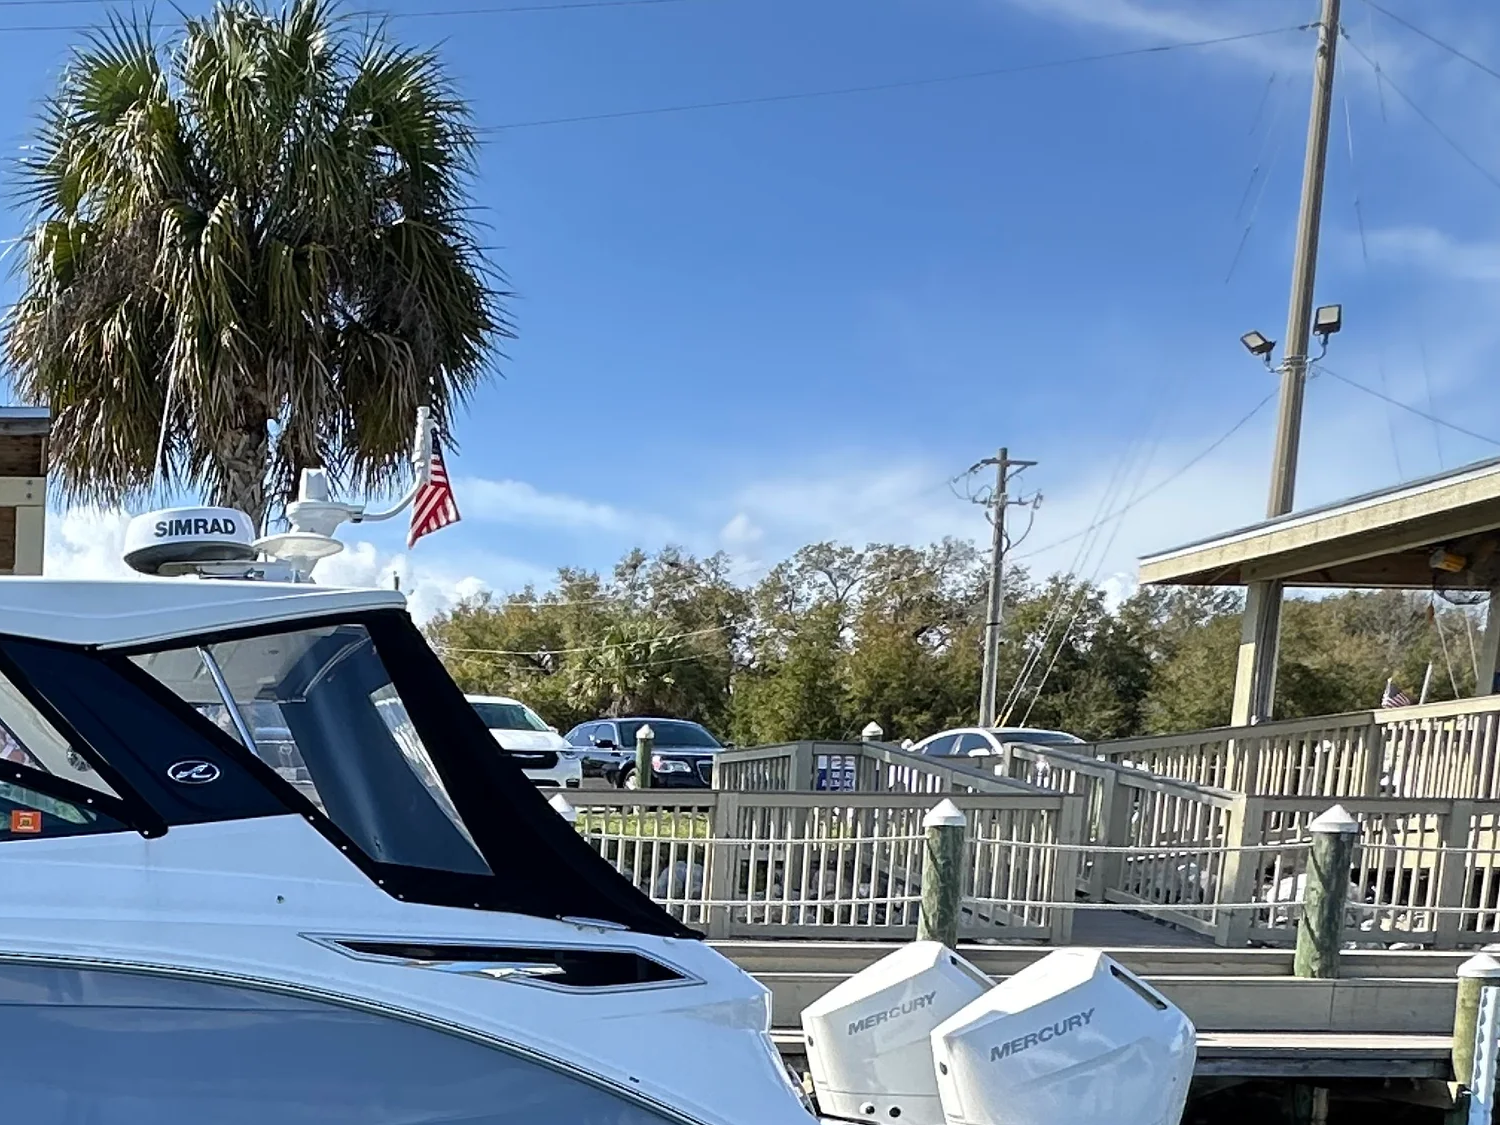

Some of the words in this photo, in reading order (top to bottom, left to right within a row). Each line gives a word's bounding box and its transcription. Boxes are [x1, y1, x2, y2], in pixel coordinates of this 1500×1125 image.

[154, 518, 236, 538] SIMRAD
[848, 990, 937, 1036] MERCURY
[990, 1007, 1096, 1062] MERCURY
